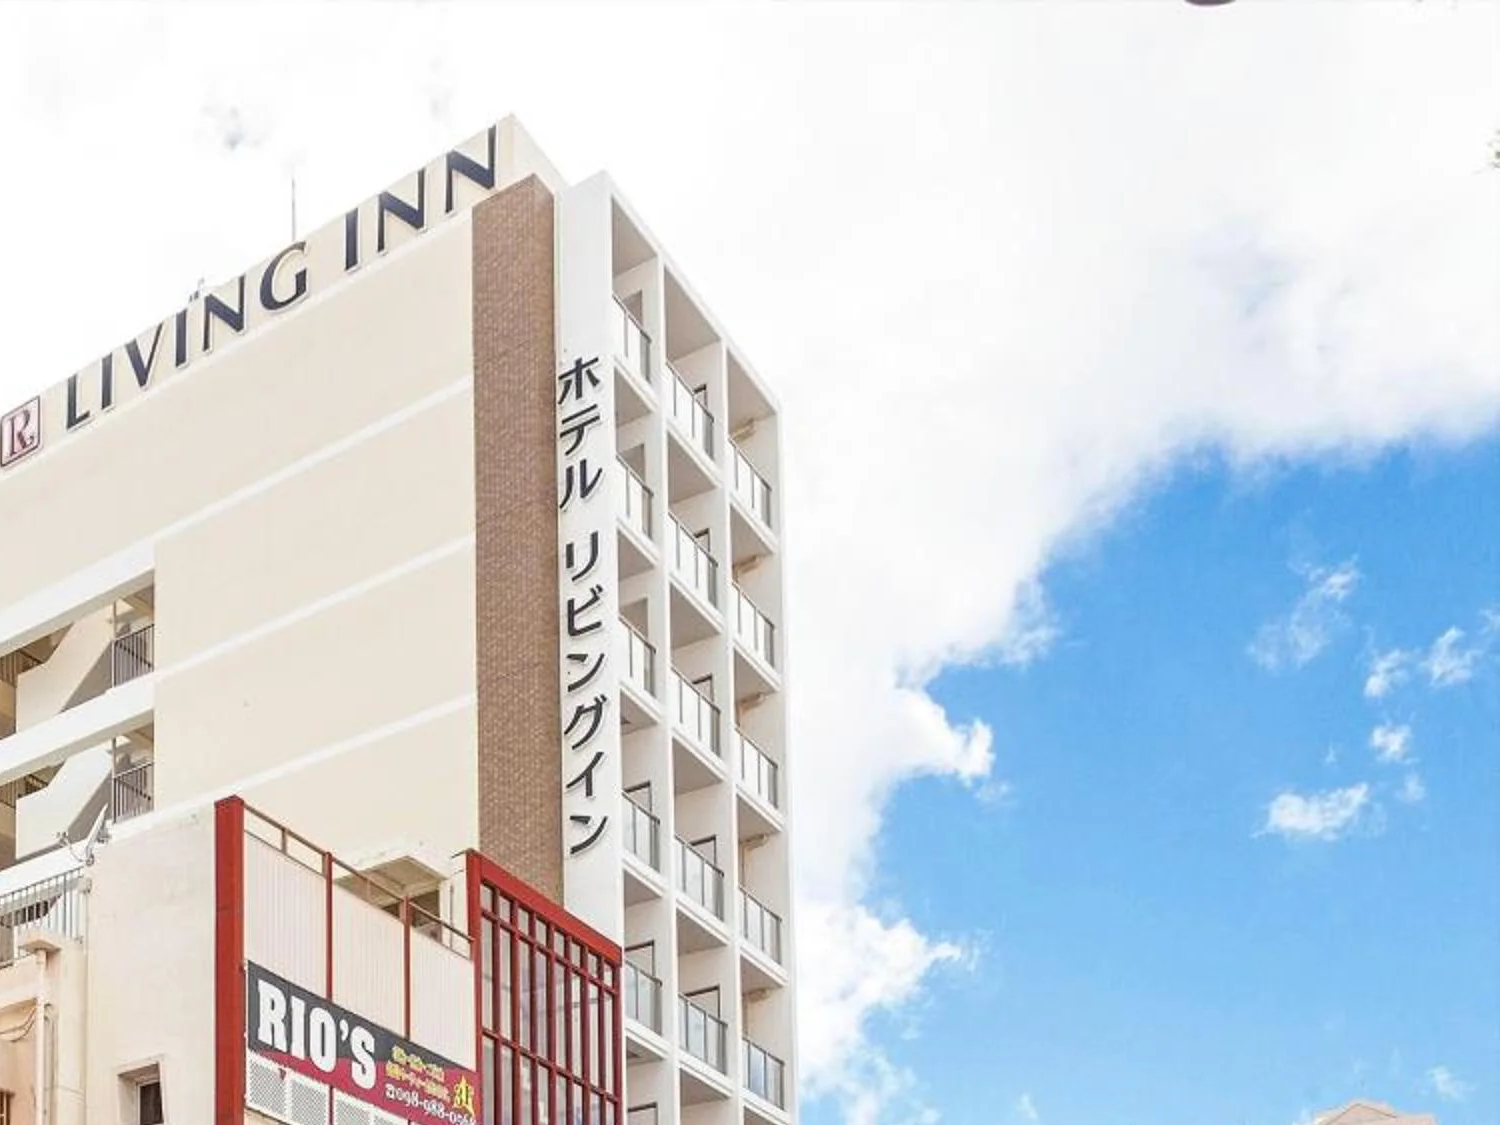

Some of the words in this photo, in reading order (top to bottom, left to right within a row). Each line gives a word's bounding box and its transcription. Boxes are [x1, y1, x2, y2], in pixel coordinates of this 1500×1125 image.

[66, 241, 309, 431] LIVING
[345, 125, 498, 272] INN
[558, 357, 603, 509] ホテル
[564, 532, 609, 856] リビングイン
[257, 979, 377, 1090] RIO'S
